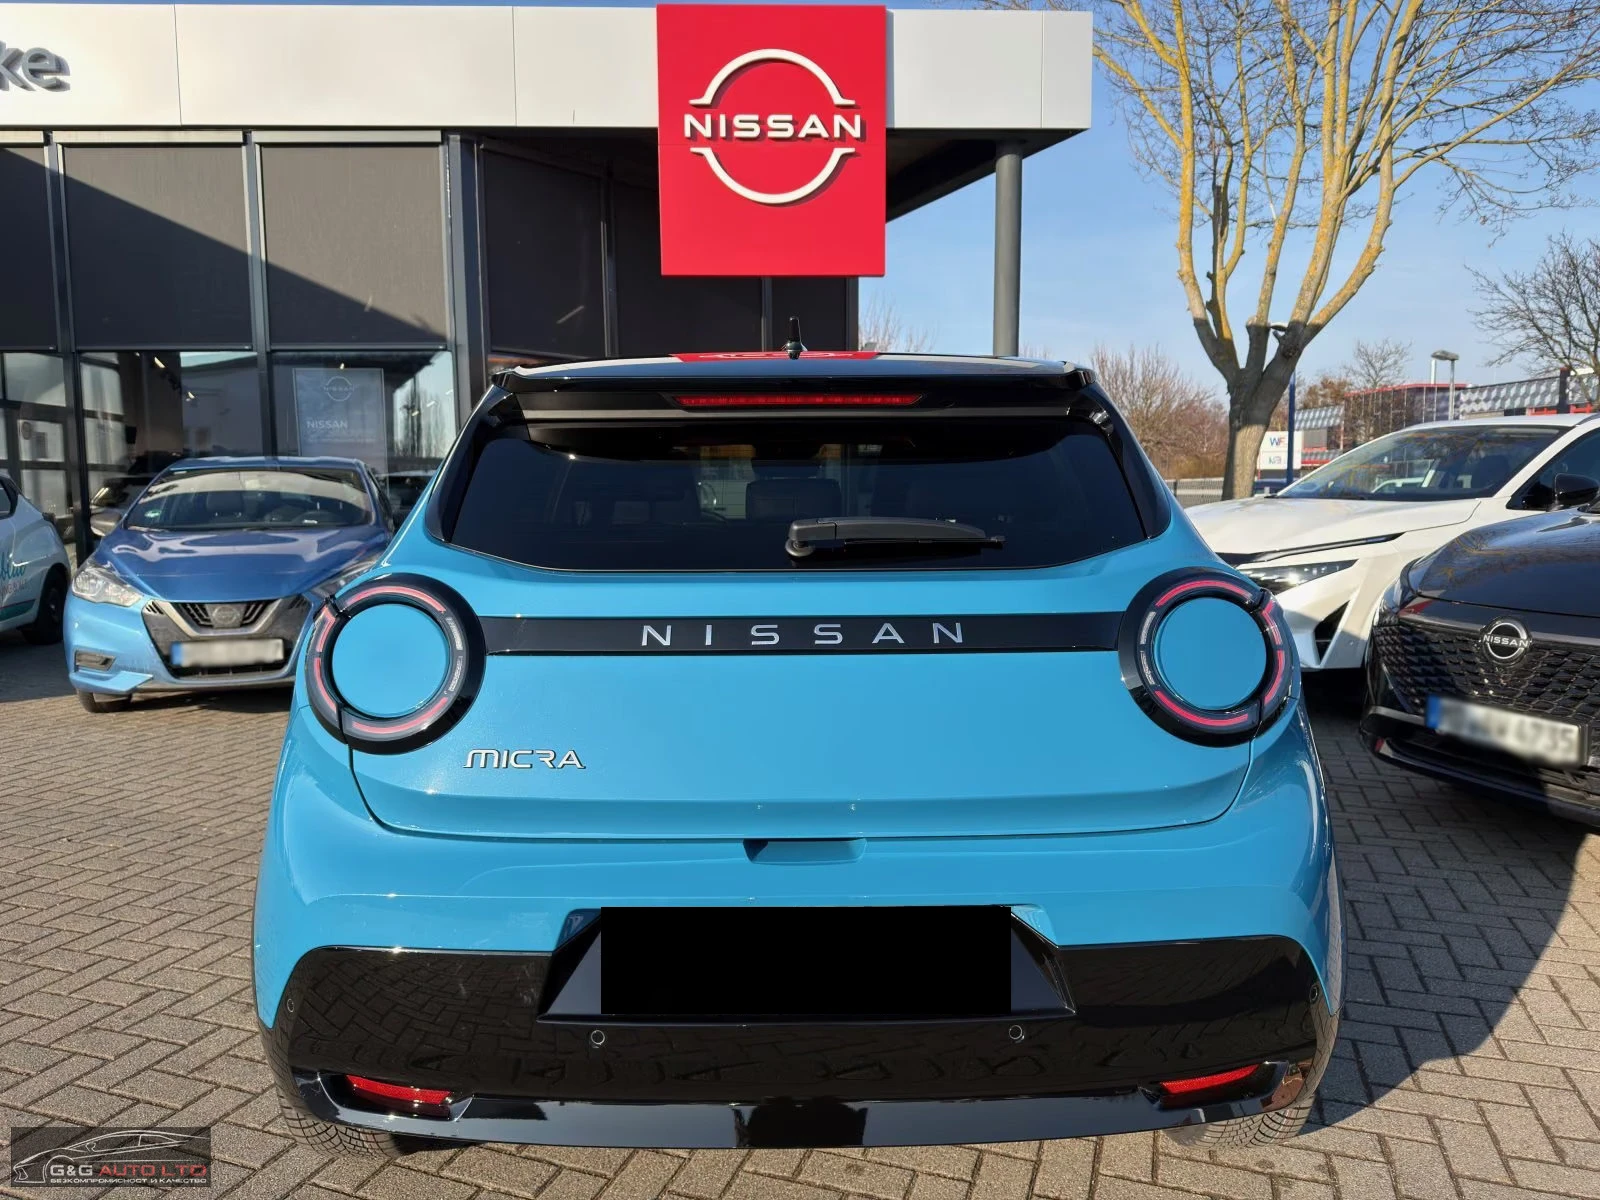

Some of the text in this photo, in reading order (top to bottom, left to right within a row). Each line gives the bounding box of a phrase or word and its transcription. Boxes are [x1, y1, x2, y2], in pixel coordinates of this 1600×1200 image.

[684, 113, 865, 141] NISSAN
[306, 420, 348, 429] NISSAN
[641, 622, 963, 646] NISSAN
[1483, 634, 1529, 648] NISSAN
[463, 749, 586, 769] MICRA
